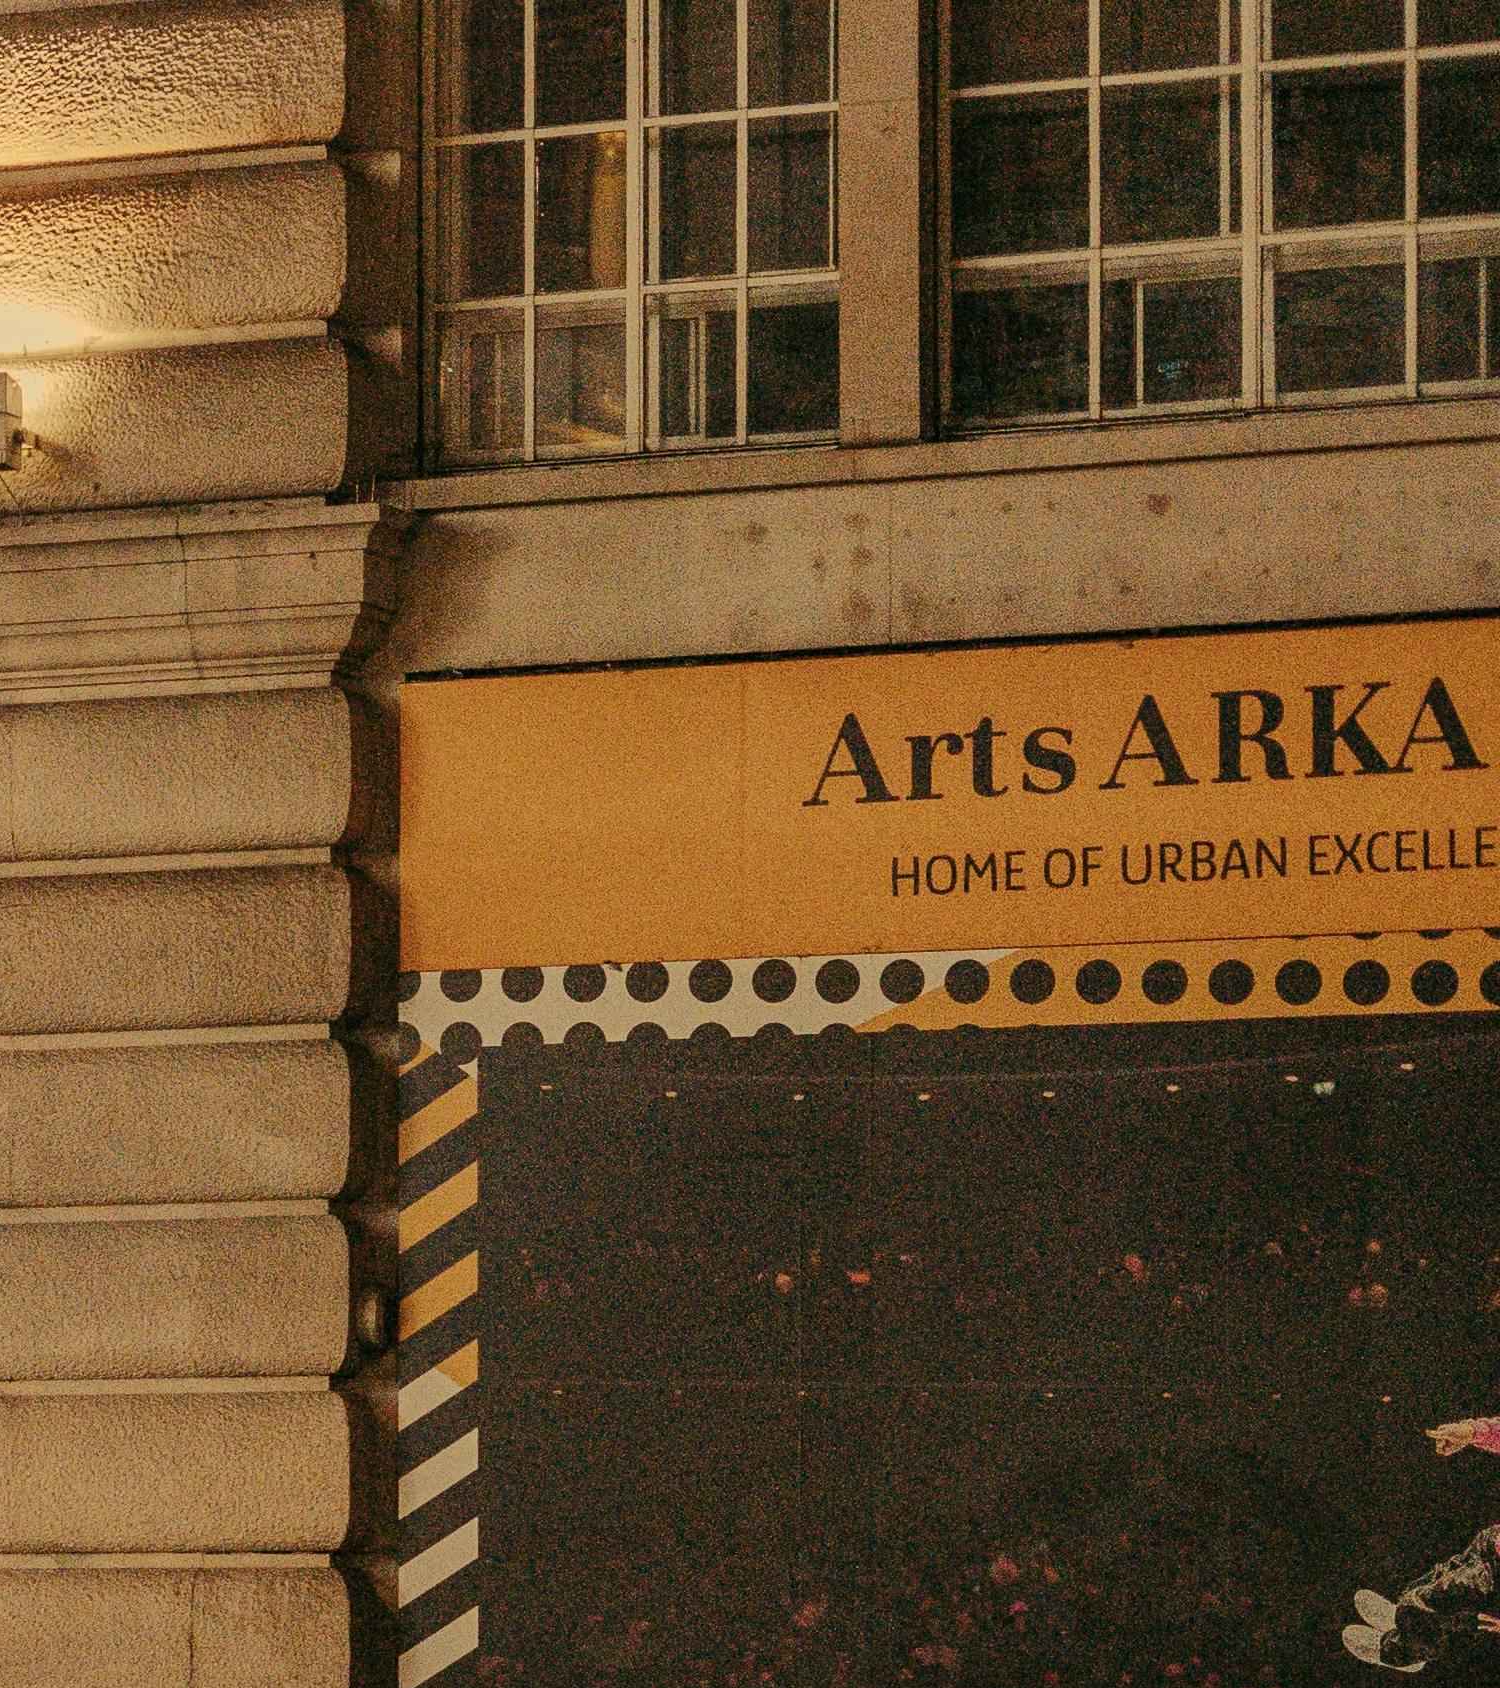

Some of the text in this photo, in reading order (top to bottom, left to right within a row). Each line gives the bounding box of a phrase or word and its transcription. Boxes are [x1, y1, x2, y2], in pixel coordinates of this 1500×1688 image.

[801, 676, 1490, 807] Arts ARKA
[891, 826, 1500, 897] HOME OF URBAN EXCELLE
